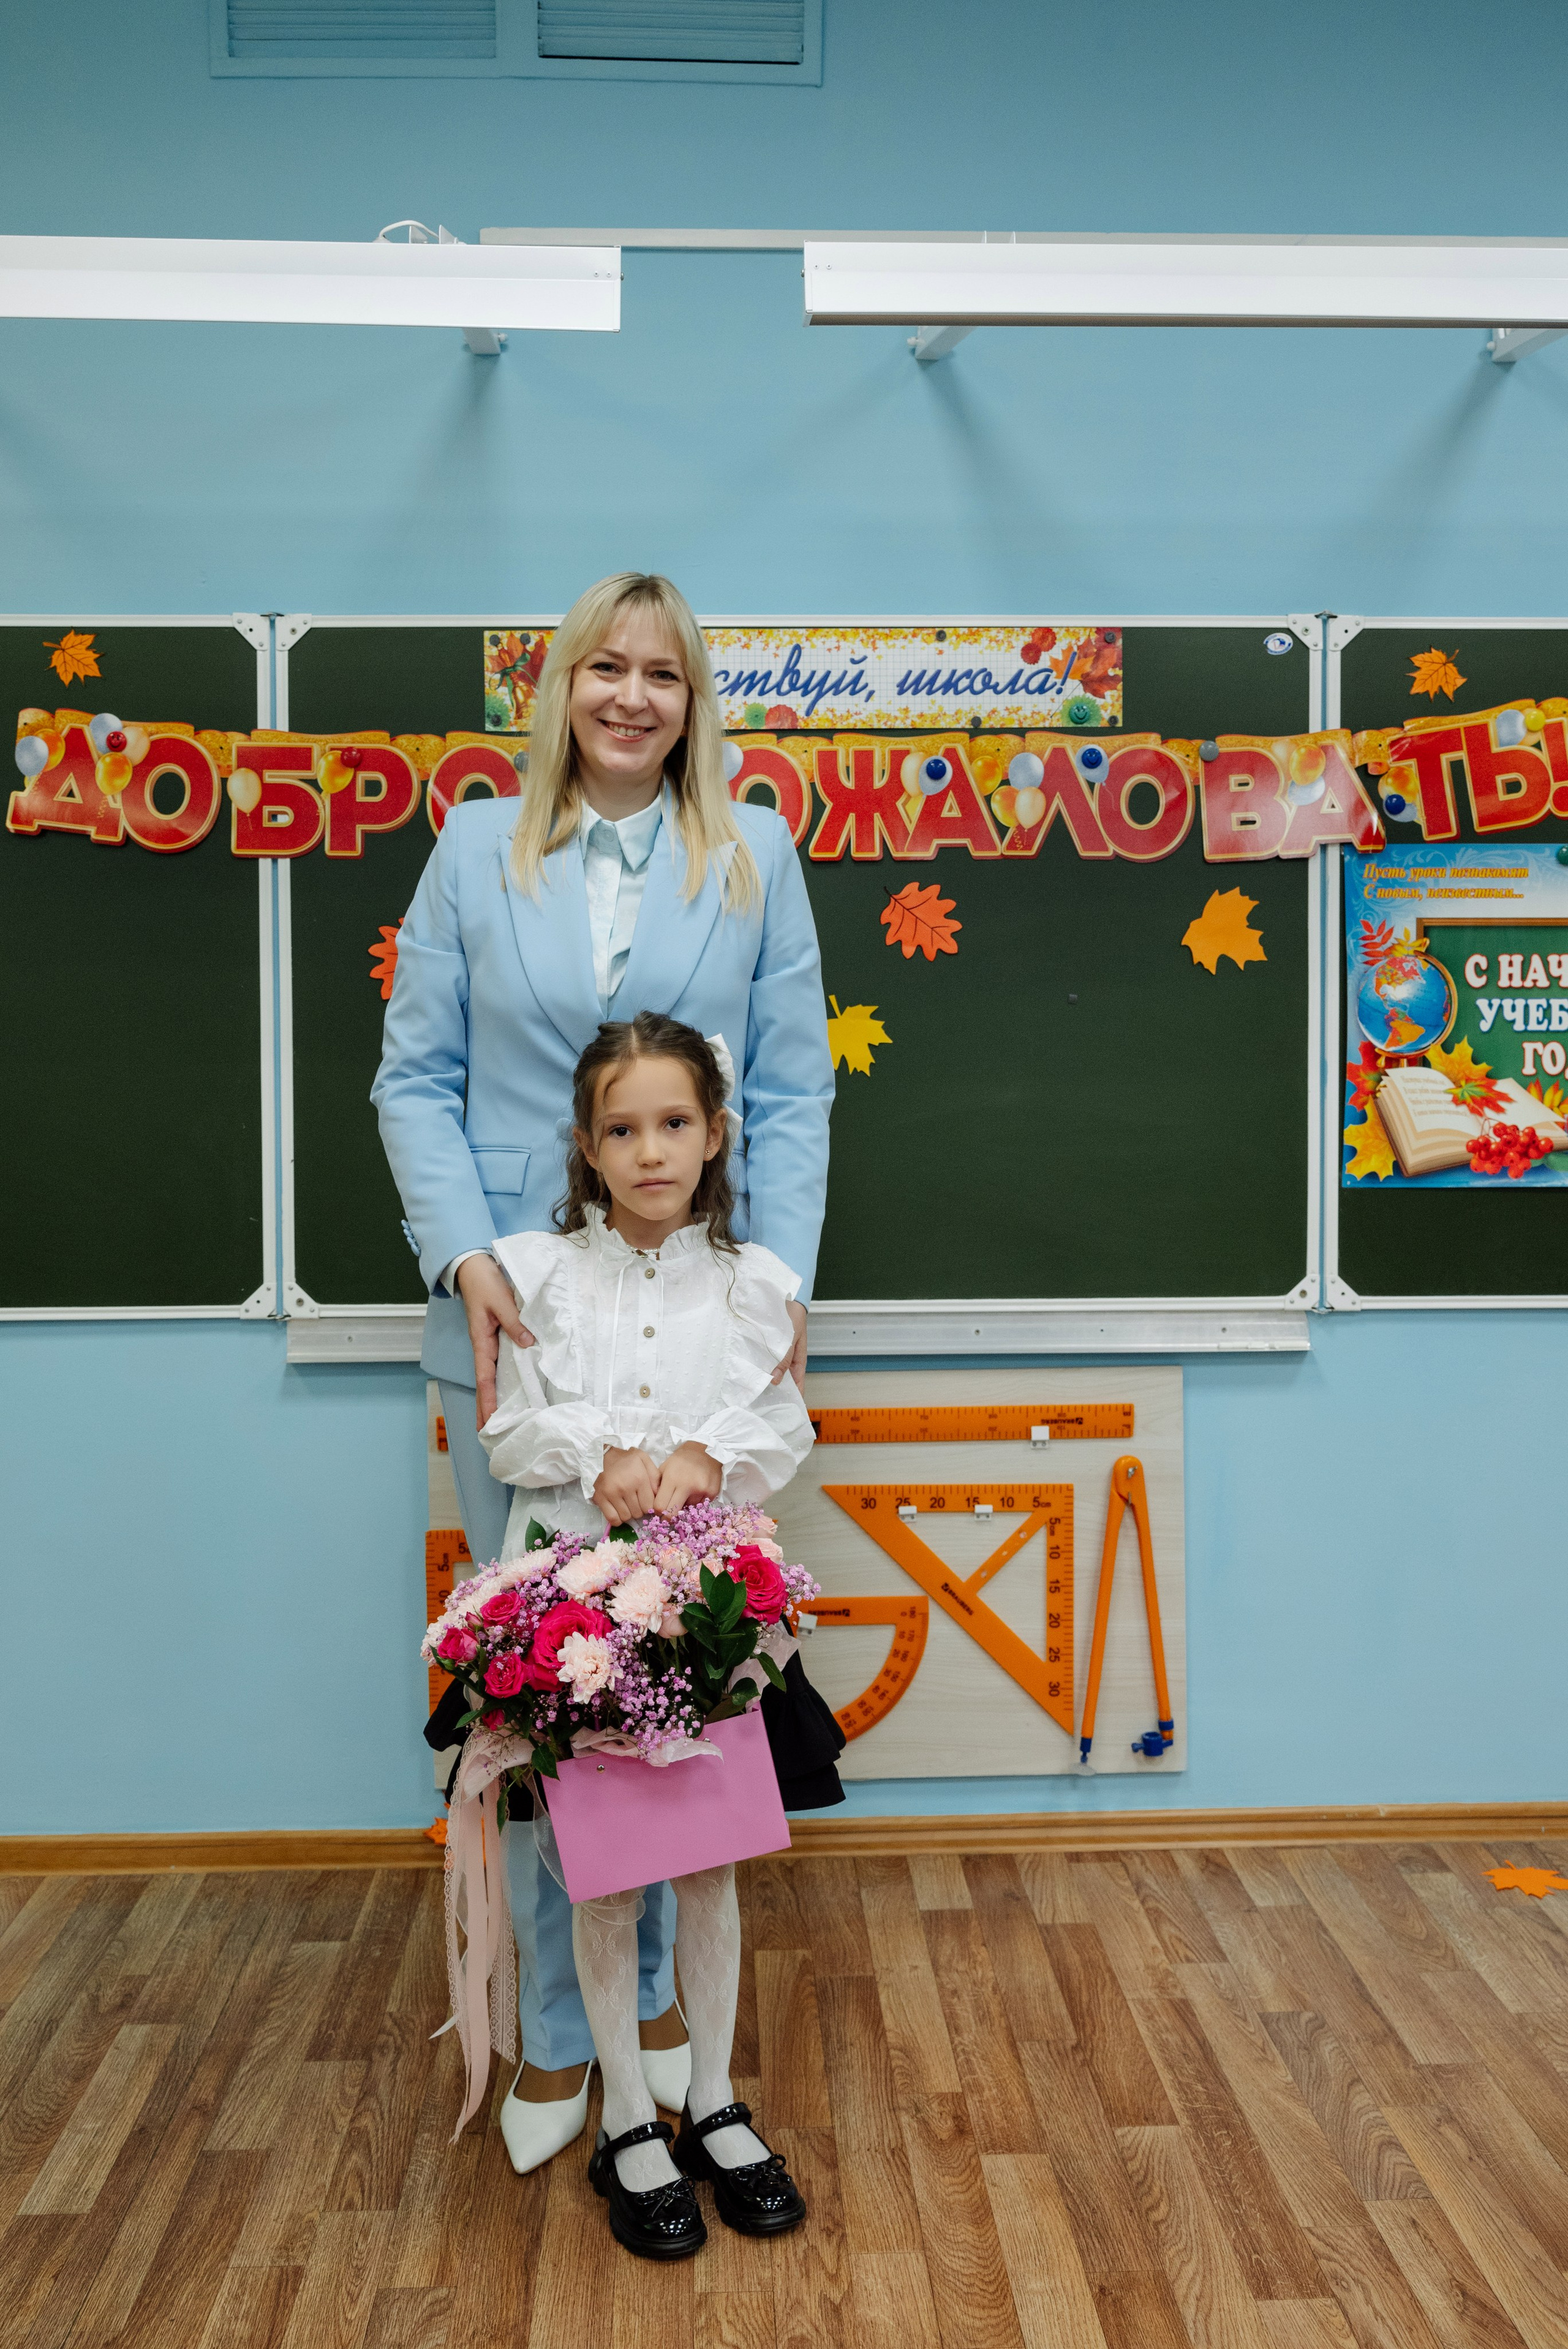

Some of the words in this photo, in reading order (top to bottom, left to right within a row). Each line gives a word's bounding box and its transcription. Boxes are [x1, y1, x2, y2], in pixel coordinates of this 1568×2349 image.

[714, 643, 876, 717] ствуй,
[896, 651, 1077, 696] школа!
[727, 717, 1568, 861] ОЖАЛОВАТЬ!
[1362, 863, 1407, 882] Пусть
[1407, 867, 1447, 882] уроки
[1449, 867, 1529, 879] познакомят
[1363, 883, 1376, 899] С
[1376, 888, 1423, 901] новым,
[1464, 953, 1488, 988] С
[1498, 953, 1568, 988] НАЧ
[1476, 997, 1568, 1033] УЧЕБ
[1521, 1041, 1568, 1080] ГО
[861, 1497, 877, 1510] 30
[895, 1497, 911, 1508] 25
[930, 1497, 946, 1509] 20
[965, 1497, 980, 1508] 15
[1000, 1496, 1015, 1508] 10
[1049, 1545, 1061, 1560] 10
[1049, 1579, 1061, 1594] 15
[1049, 1613, 1061, 1628] 20
[1049, 1646, 1061, 1663] 25
[1049, 1681, 1061, 1697] 30
